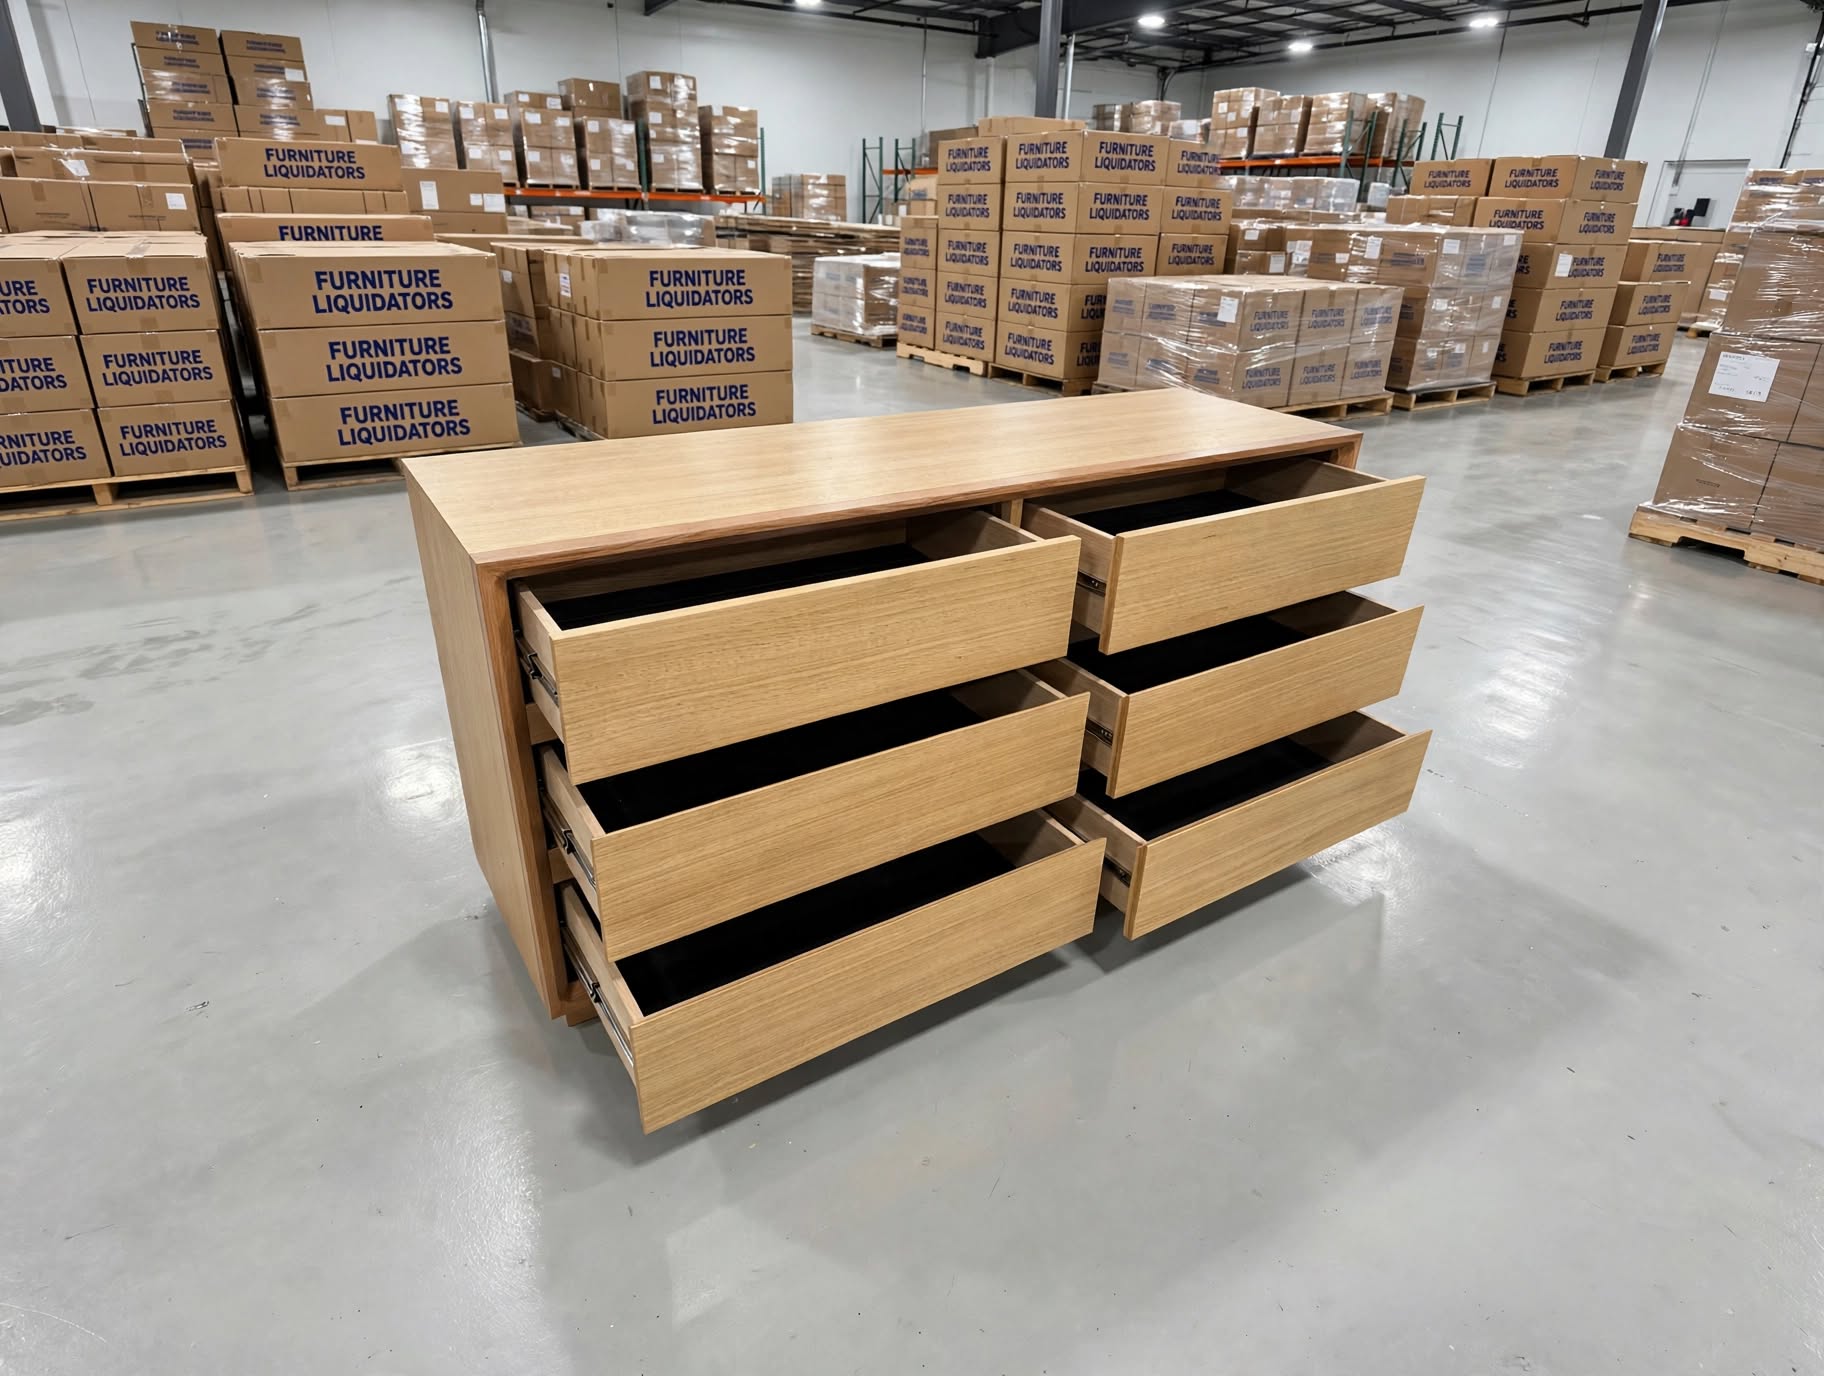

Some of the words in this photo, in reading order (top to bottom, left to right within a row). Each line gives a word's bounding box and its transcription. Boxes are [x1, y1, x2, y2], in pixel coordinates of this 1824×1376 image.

[265, 148, 356, 164] FURNITURE
[948, 147, 989, 159] FURNITURE
[1019, 142, 1068, 155] FURNITURE
[1099, 142, 1154, 157] FURNITURE
[264, 164, 365, 179] LIQUIDATORS
[1016, 157, 1069, 170] LIQUIDATORS
[1095, 157, 1156, 172] LIQUIDATORS
[1428, 169, 1470, 179] FURNITURE
[1509, 168, 1558, 178] FURNITURE
[1424, 179, 1471, 188] LIQUIDATORS
[1504, 178, 1559, 188] LIQUIDATORS
[948, 194, 988, 205] FURNITURE
[1016, 192, 1064, 205] FURNITURE
[1094, 193, 1148, 206] FURNITURE
[1176, 196, 1221, 209] FURNITURE
[1013, 206, 1066, 219] LIQUIDATORS
[1089, 208, 1149, 221] LIQUIDATORS
[1494, 209, 1544, 219] FURNITURE
[279, 225, 383, 241] FURNITURE
[948, 240, 987, 253] FURNITURE
[1014, 243, 1060, 258] FURNITURE
[1089, 247, 1142, 259] FURNITURE
[1172, 244, 1213, 254] FURNITURE
[1010, 257, 1062, 272] LIQUIDATORS
[1085, 261, 1144, 274] LIQUIDATORS
[87, 277, 190, 294] FURNITURE
[315, 269, 441, 290] FURNITURE
[649, 270, 746, 287] FURNITURE
[947, 281, 984, 296] FURNITURE
[1011, 288, 1056, 304] FURNITURE
[86, 294, 200, 312] LIQUIDATORS
[312, 291, 453, 314] LIQUIDATORS
[646, 289, 753, 308] LIQUIDATORS
[1008, 302, 1058, 319] LIQUIDATORS
[654, 328, 748, 347] FURNITURE
[1008, 333, 1052, 351] FURNITURE
[328, 337, 451, 360] FURNITURE
[1005, 345, 1054, 365] LIQUIDATORS
[103, 350, 203, 368] FURNITURE
[650, 347, 755, 367] LIQUIDATORS
[0, 357, 56, 374] ITURE
[326, 357, 463, 382] LIQUIDATORS
[0, 374, 67, 392] DATORS
[102, 366, 213, 386] LIQUIDATORS
[656, 384, 749, 405] FURNITURE
[340, 400, 460, 424] FURNITURE
[652, 402, 756, 424] LIQUIDATORS
[120, 420, 217, 439] FURNITURE
[338, 419, 471, 446] LIQUIDATORS
[0, 430, 75, 449] RNITURE
[119, 435, 227, 456] LIQUIDATORS
[0, 446, 87, 468] UIDATORS
